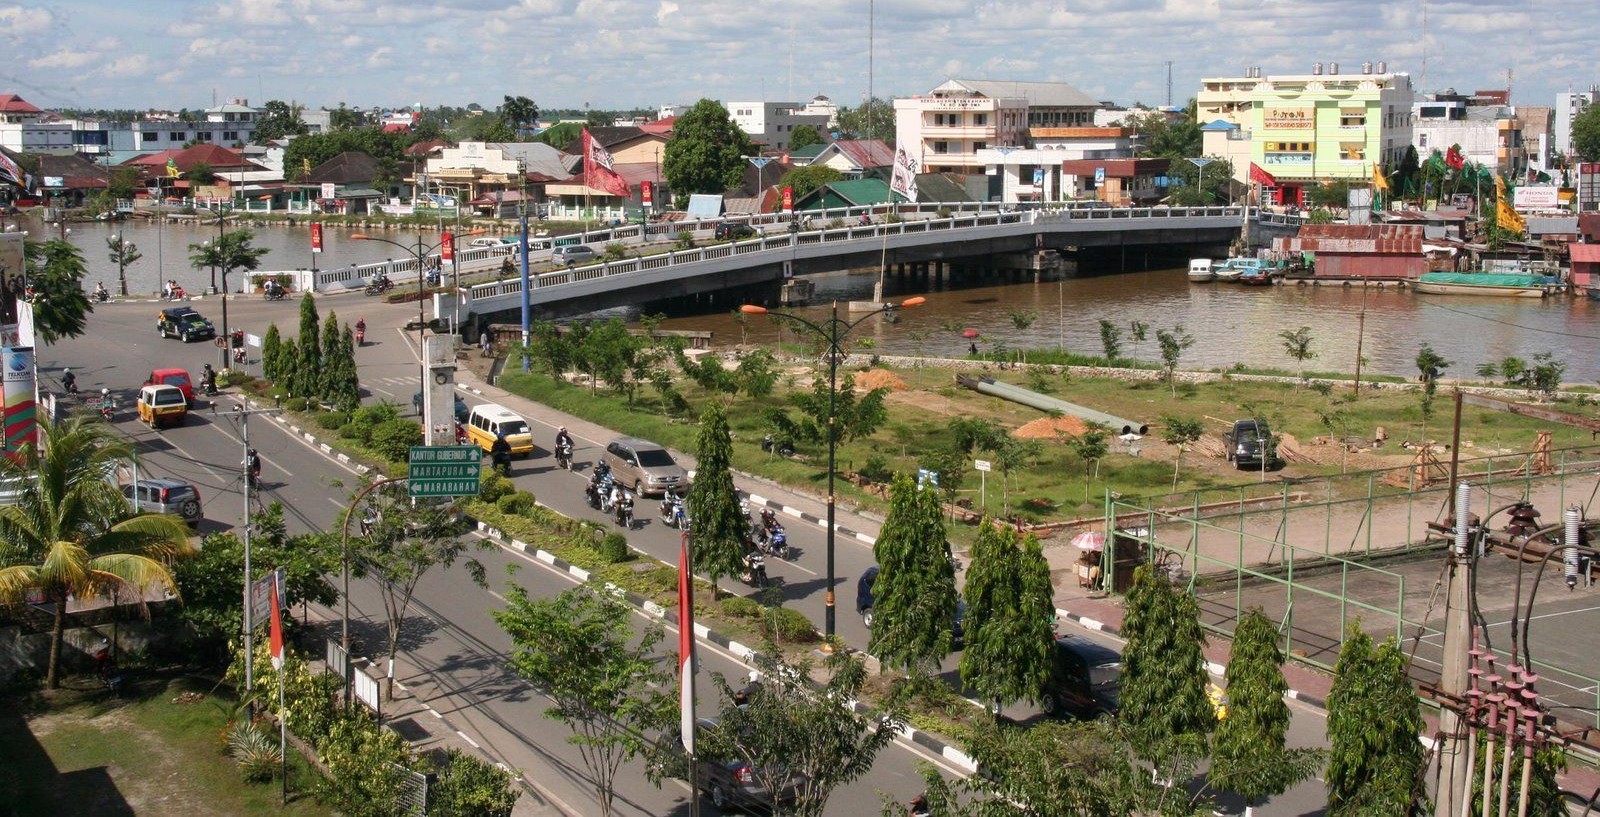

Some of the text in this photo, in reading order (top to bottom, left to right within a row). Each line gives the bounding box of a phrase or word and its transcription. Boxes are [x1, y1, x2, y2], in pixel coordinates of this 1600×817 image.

[411, 450, 467, 460] KANTOR GUBERNUR
[412, 466, 464, 476] MARTAPURA
[423, 482, 476, 492] MARABAHAN
